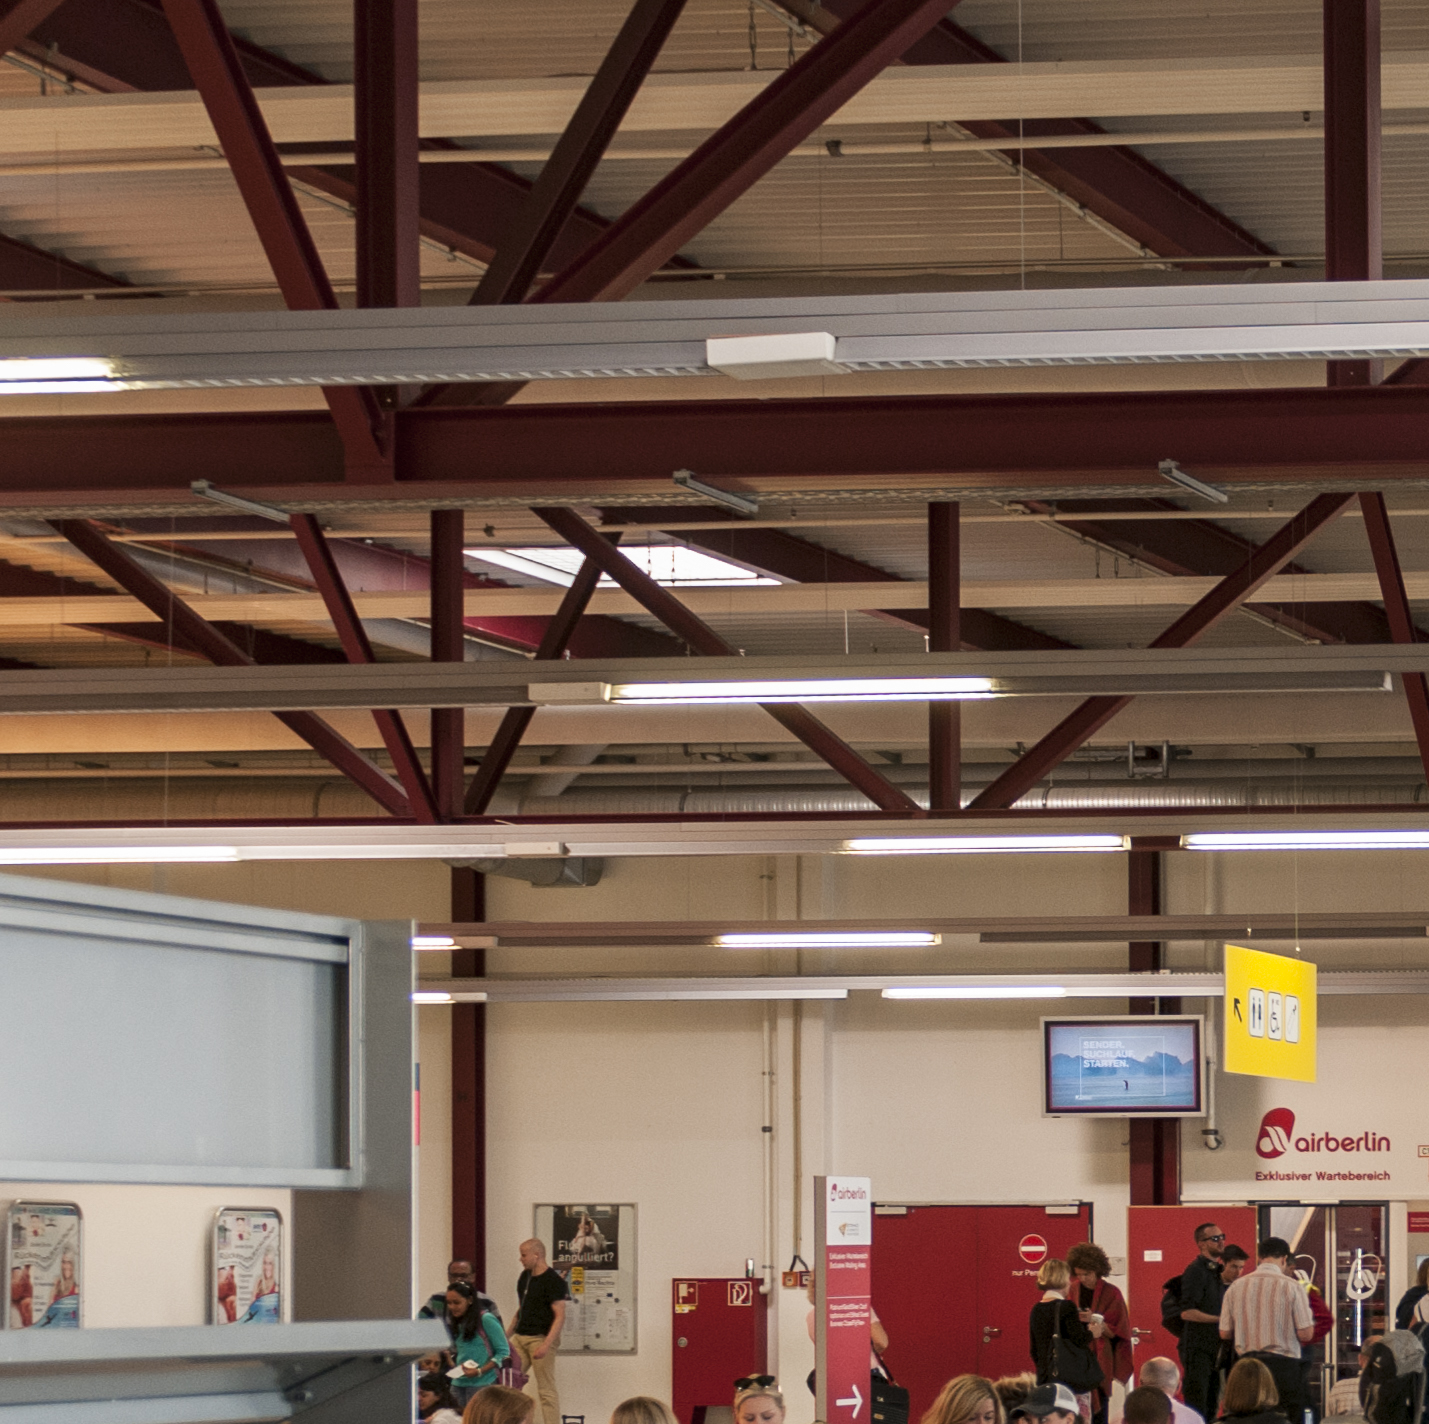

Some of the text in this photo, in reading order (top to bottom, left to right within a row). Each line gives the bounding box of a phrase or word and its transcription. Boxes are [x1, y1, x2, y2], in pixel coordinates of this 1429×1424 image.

[1083, 1040, 1125, 1049] SENDER.
[1083, 1059, 1130, 1068] STARTEN.
[1294, 1131, 1391, 1153] airberlin
[1255, 1170, 1391, 1182] Exklusiver Wartebereich
[837, 1187, 867, 1200] airberlin
